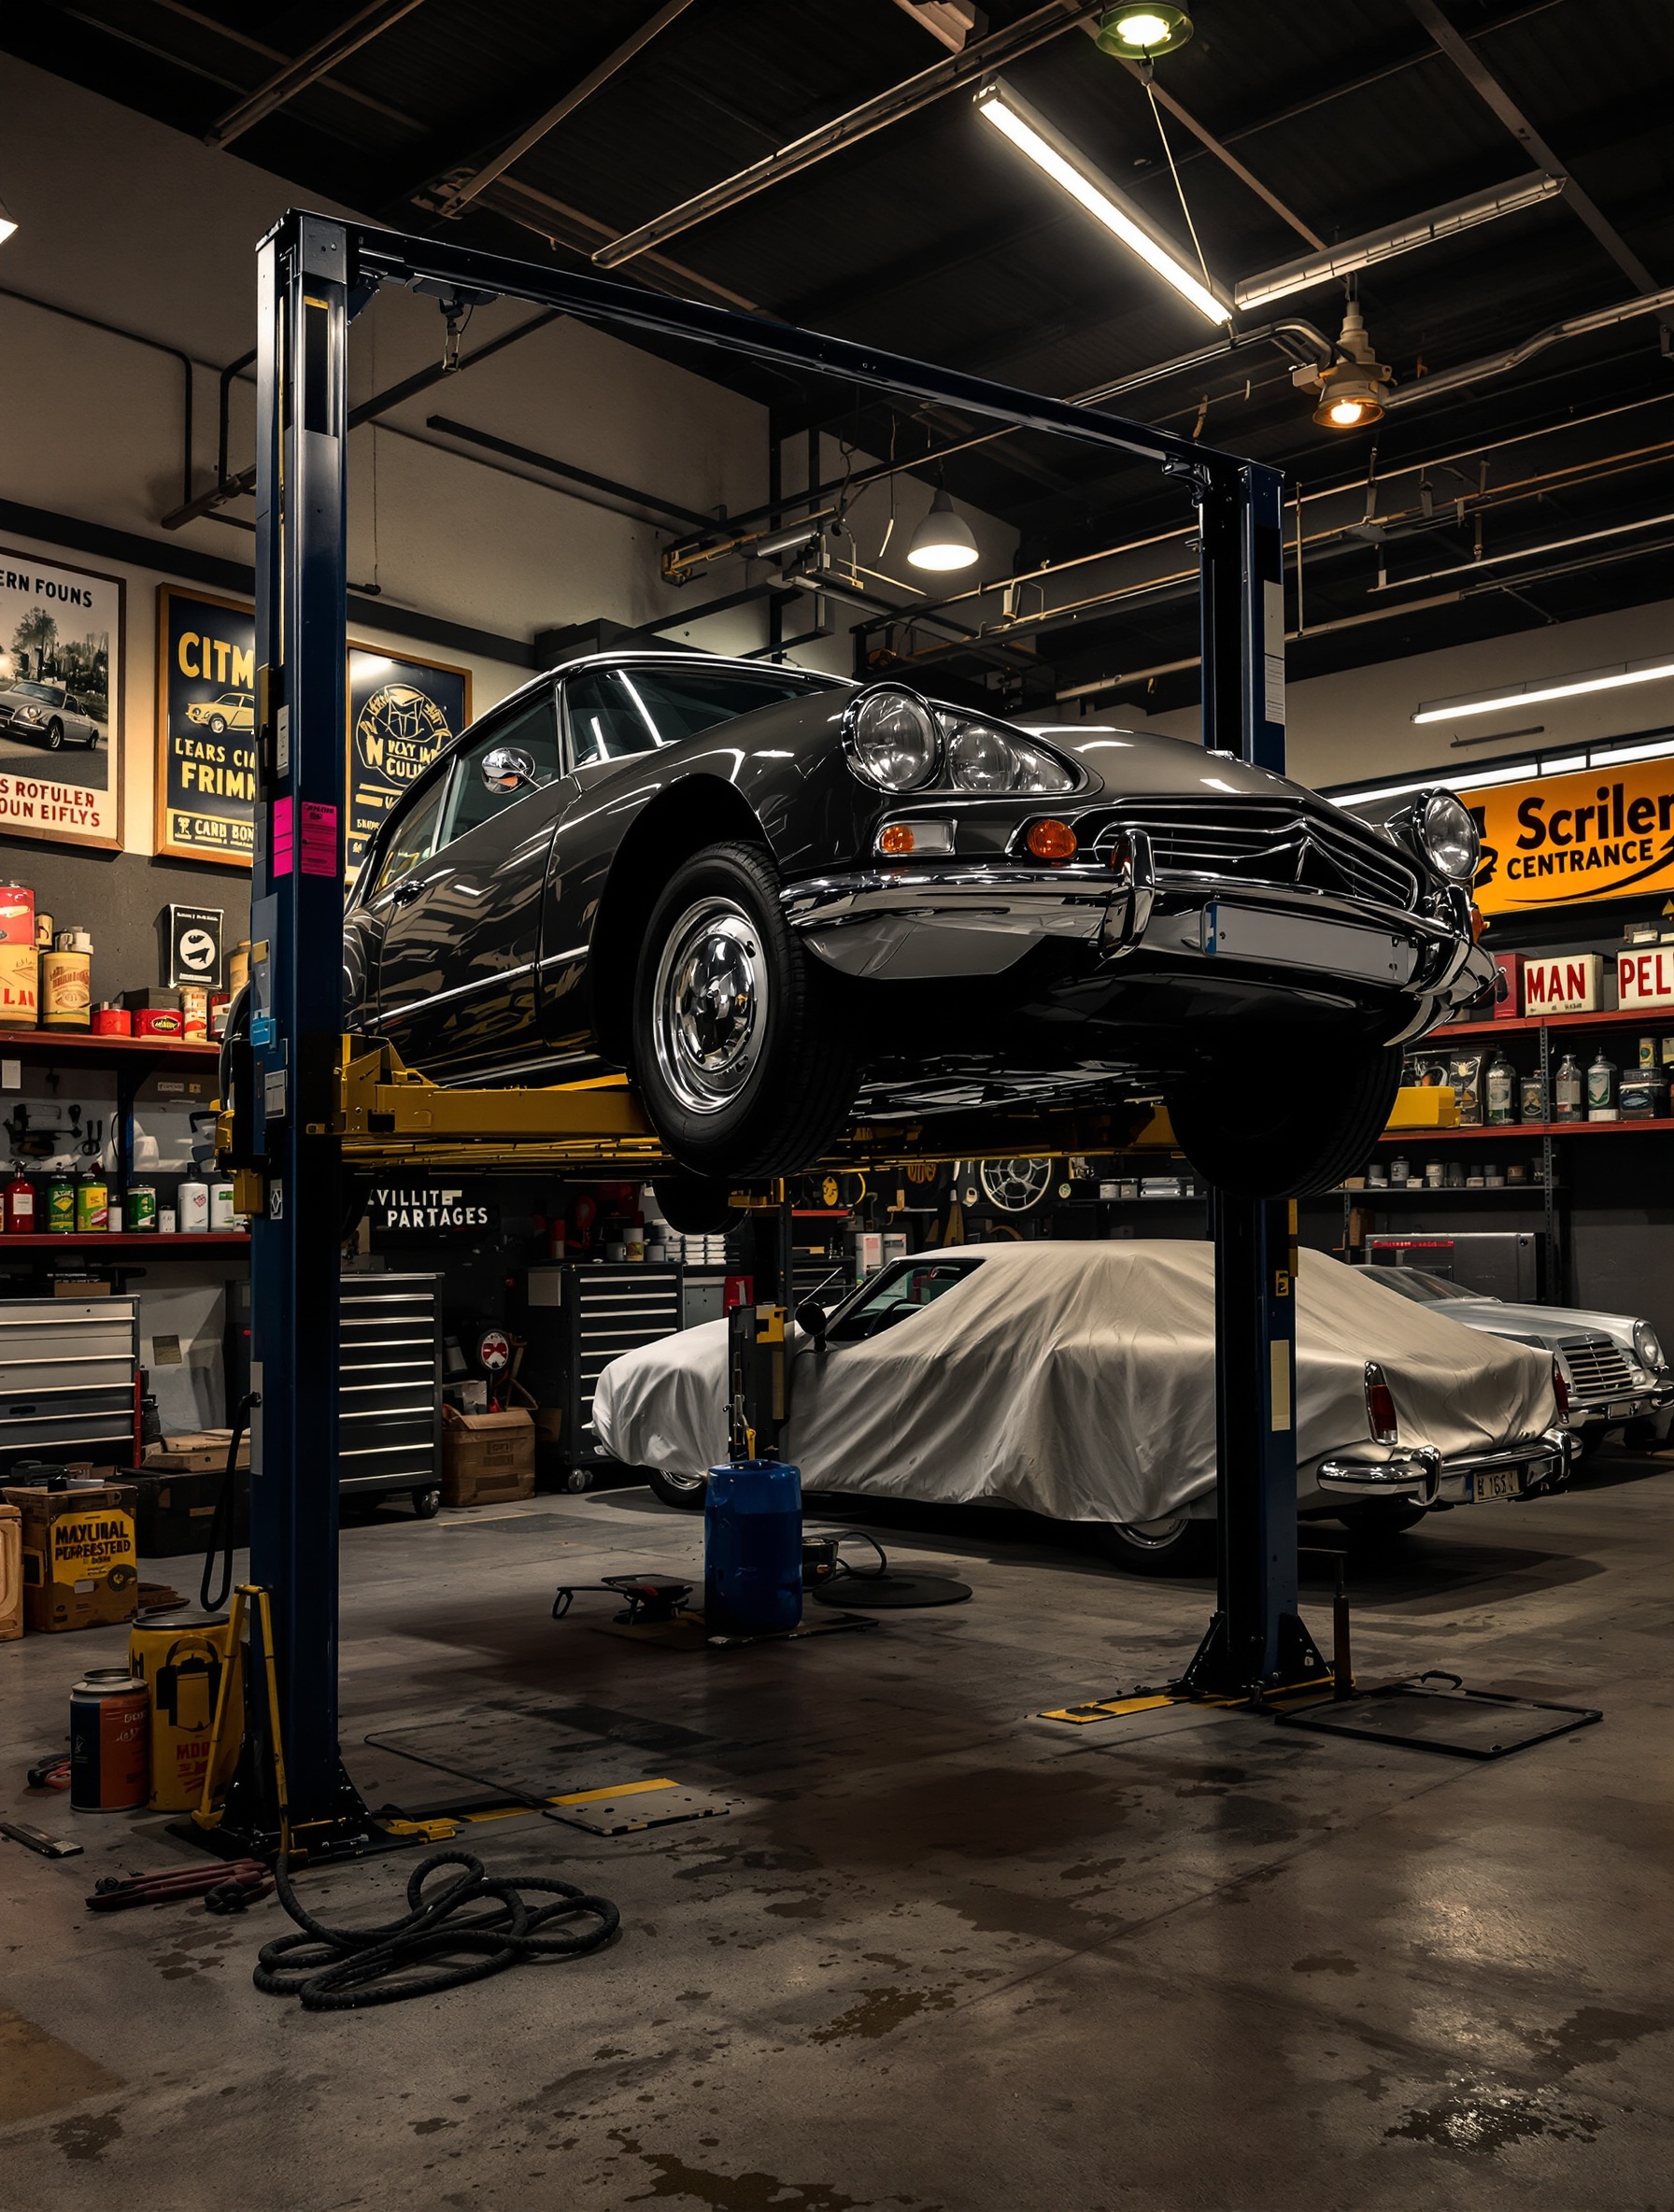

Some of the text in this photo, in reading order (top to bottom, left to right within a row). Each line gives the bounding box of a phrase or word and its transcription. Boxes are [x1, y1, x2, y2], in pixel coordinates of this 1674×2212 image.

[35, 578, 92, 608] FOUNS
[175, 737, 226, 763] LEARS
[16, 781, 94, 808] ROTULER
[41, 804, 100, 828] EIFLYS
[1507, 838, 1653, 880] CENTRANCE
[1527, 963, 1586, 1005] MAN
[387, 1206, 488, 1228] PARTAGES
